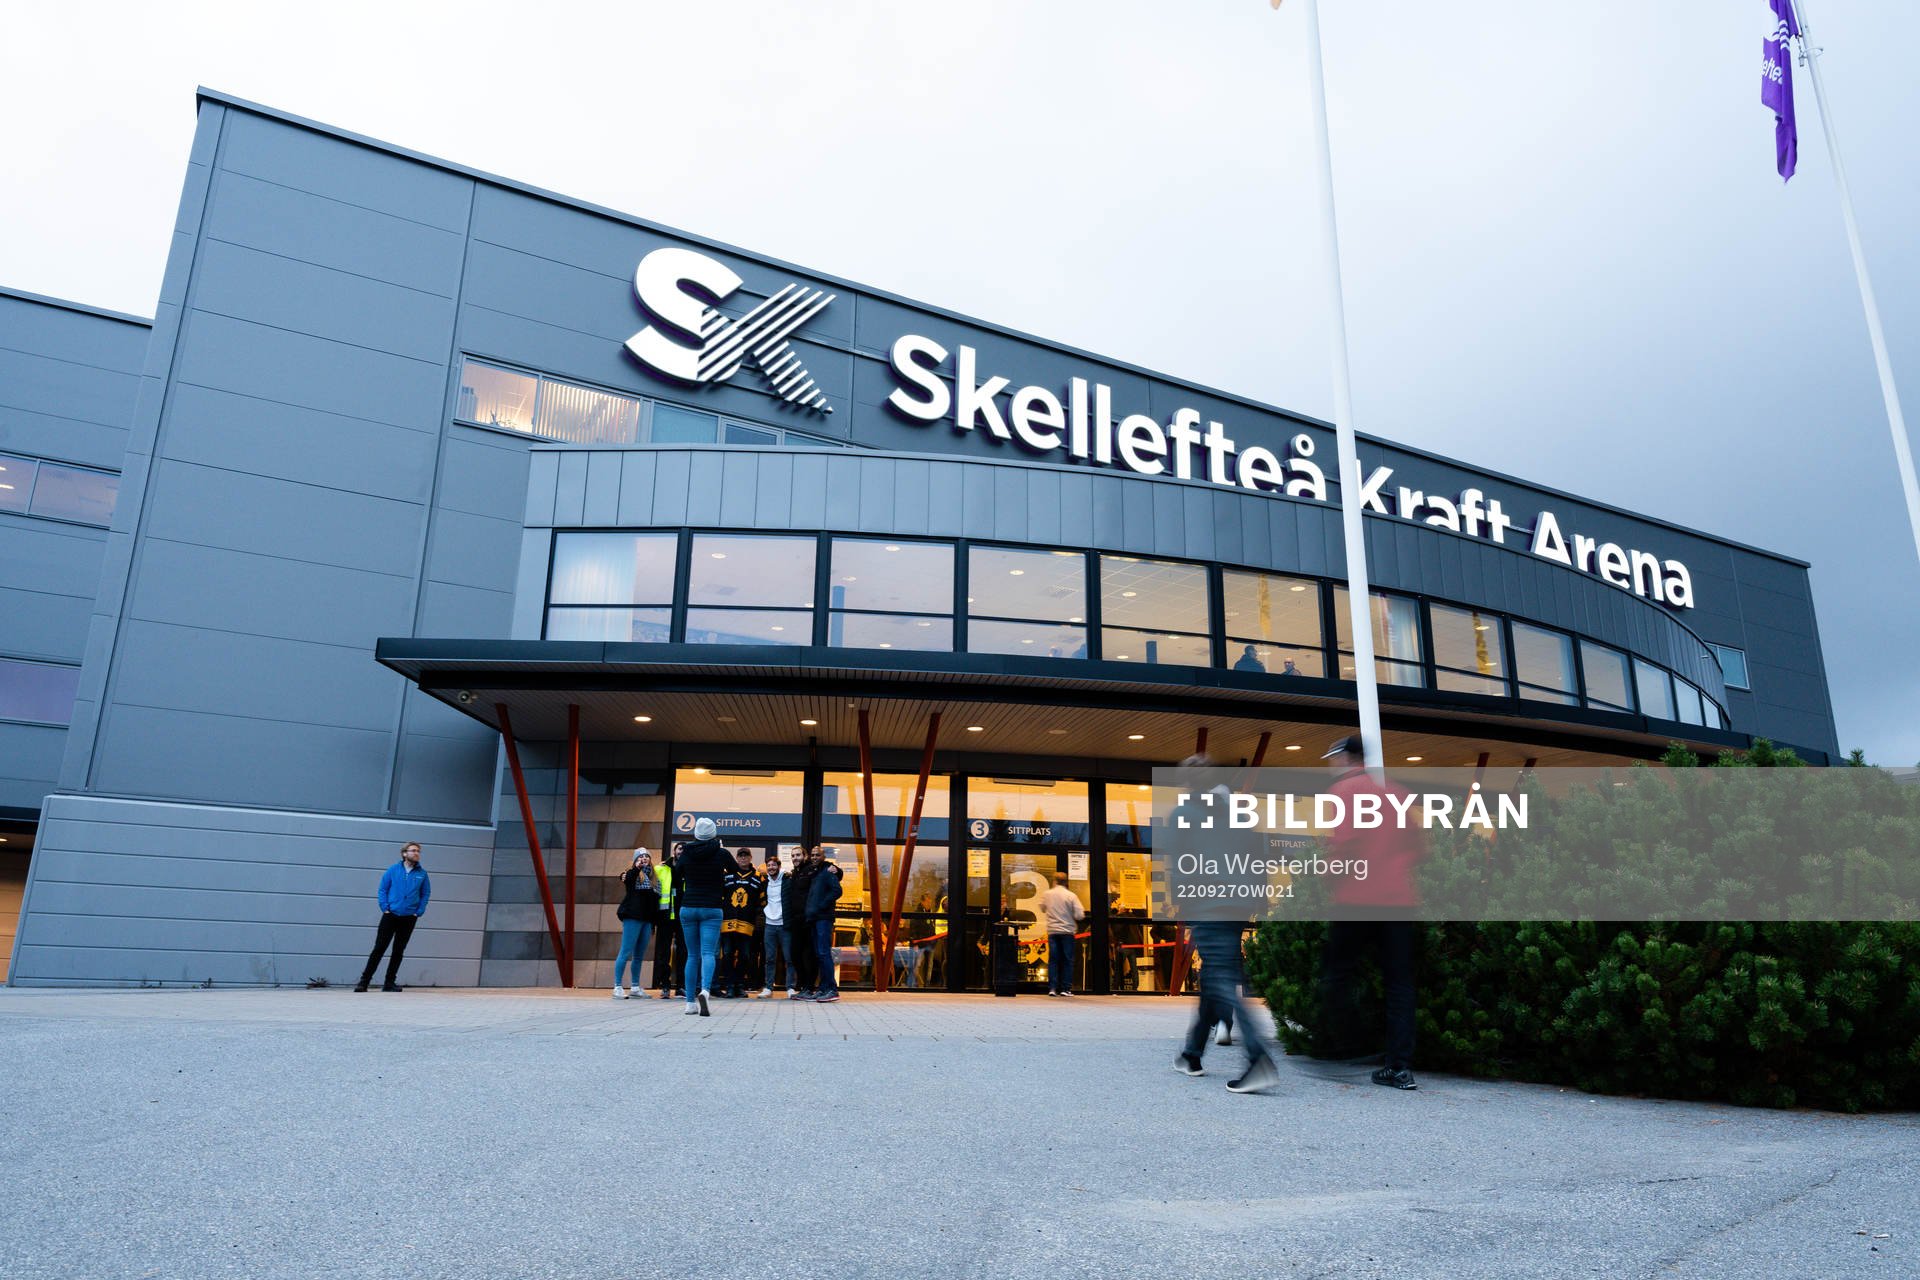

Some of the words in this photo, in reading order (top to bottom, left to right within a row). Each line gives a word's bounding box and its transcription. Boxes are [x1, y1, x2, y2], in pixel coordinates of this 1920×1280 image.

[888, 334, 1327, 501] Skellefteå
[1356, 459, 1511, 543] Kraft
[1530, 511, 1694, 609] Arena
[716, 818, 761, 828] SITTPLATS
[1008, 826, 1051, 836] SITTPLATS
